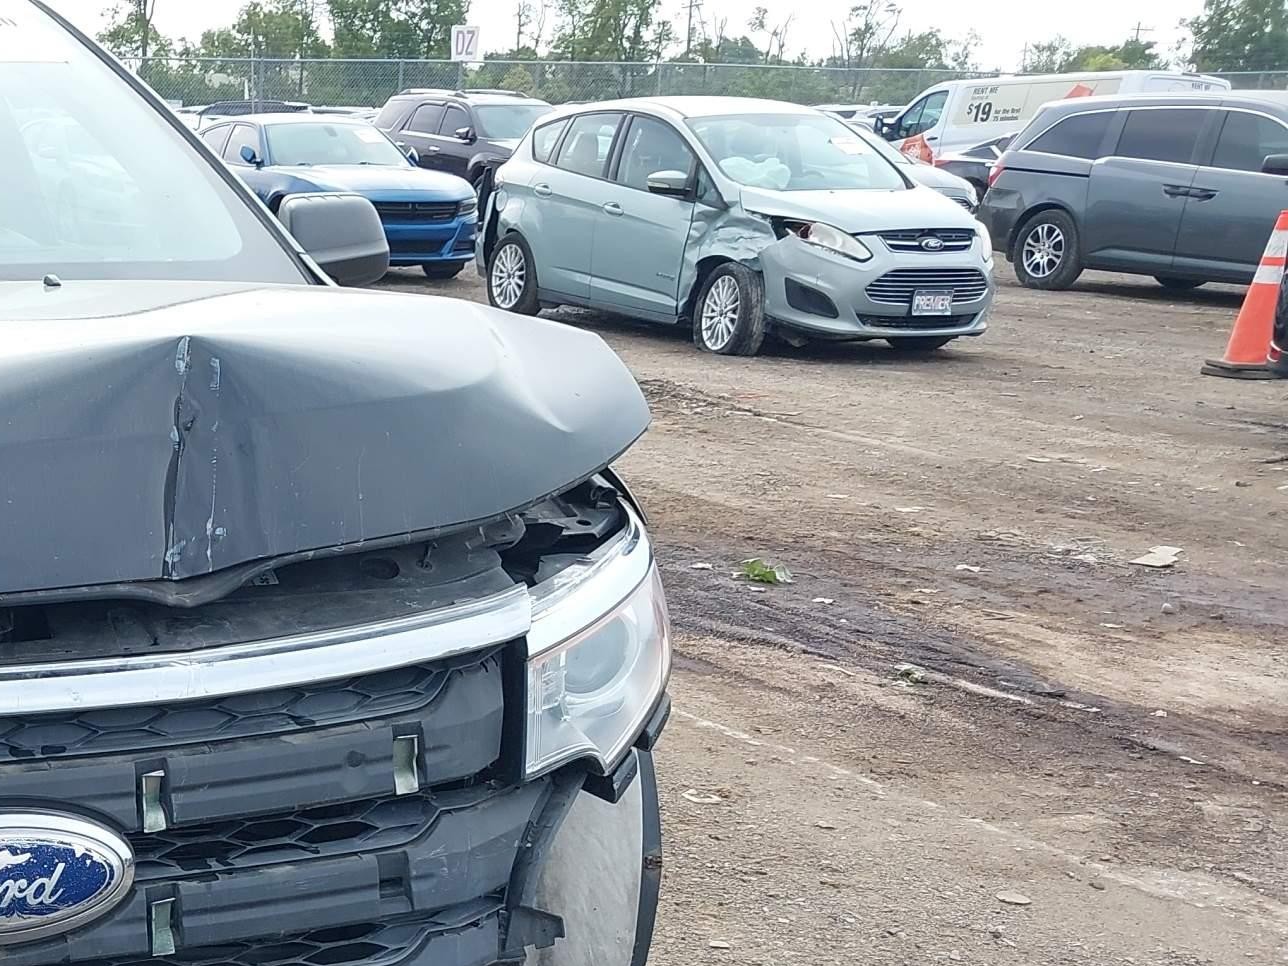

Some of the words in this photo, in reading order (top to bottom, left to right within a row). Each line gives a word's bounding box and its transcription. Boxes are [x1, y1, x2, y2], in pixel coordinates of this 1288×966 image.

[973, 87, 988, 95] RENT
[967, 102, 993, 122] $19
[915, 295, 951, 310] PREMIER
